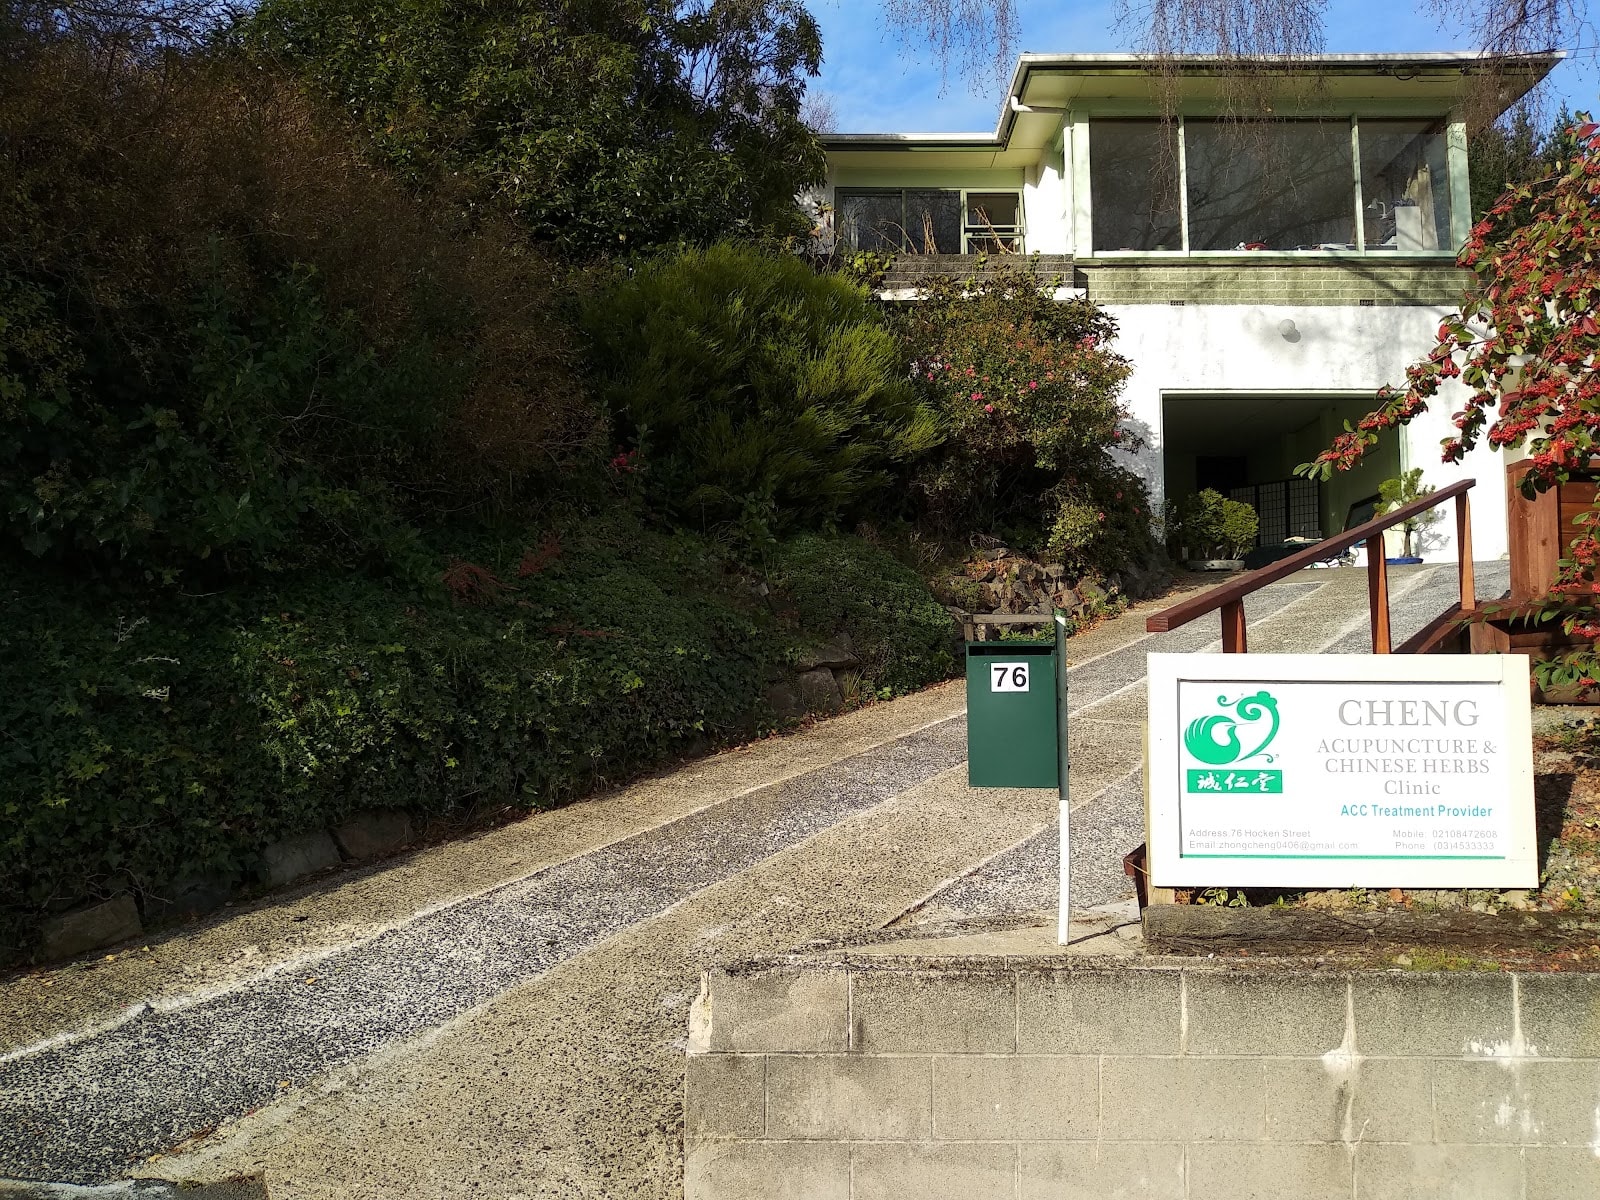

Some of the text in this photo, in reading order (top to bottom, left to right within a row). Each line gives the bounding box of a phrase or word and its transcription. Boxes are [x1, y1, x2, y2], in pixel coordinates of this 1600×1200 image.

[993, 666, 1027, 688] 76
[1338, 699, 1480, 727] CHENG
[1317, 739, 1497, 754] ACUPUNCTURE &
[1325, 758, 1490, 773] CHINESE HERBS
[1384, 779, 1441, 795] Clinic
[1340, 804, 1493, 817] ACC Treatment Provider
[1244, 829, 1280, 839] Hocken
[1282, 829, 1311, 839] Street
